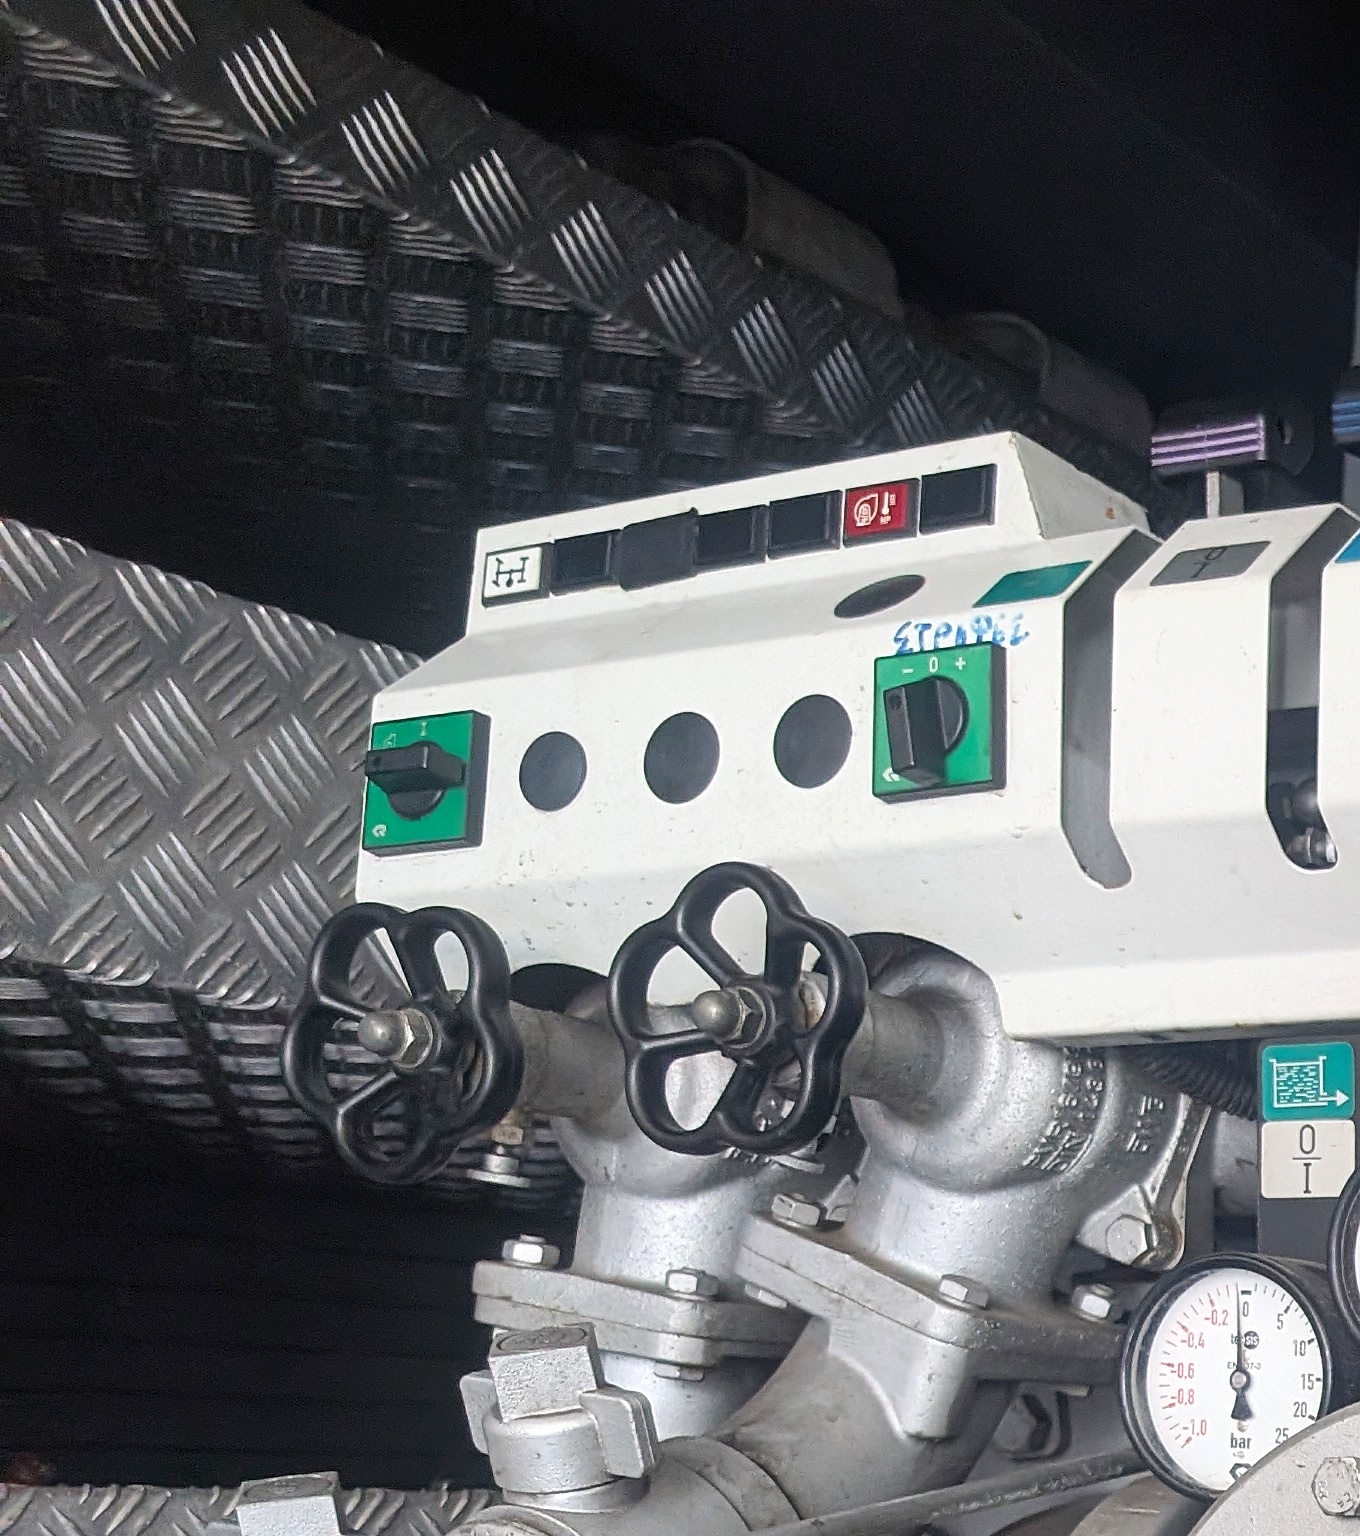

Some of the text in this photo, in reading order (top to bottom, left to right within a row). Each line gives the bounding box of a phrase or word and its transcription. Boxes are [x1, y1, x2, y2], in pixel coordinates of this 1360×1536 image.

[928, 656, 939, 673] 0
[1299, 1124, 1316, 1155] 0
[1204, 1309, 1229, 1327] -0,2
[1242, 1301, 1250, 1318] 0
[1276, 1313, 1284, 1331] 5
[1180, 1332, 1206, 1350] -0,4
[1293, 1339, 1306, 1357] 10
[1170, 1362, 1195, 1380] -0,6
[1300, 1373, 1315, 1390] 15
[1170, 1387, 1195, 1405] -0,8
[1293, 1401, 1308, 1418] 20
[1182, 1418, 1207, 1437] -1,0
[1275, 1427, 1289, 1445] 25
[1230, 1433, 1252, 1450] bar
